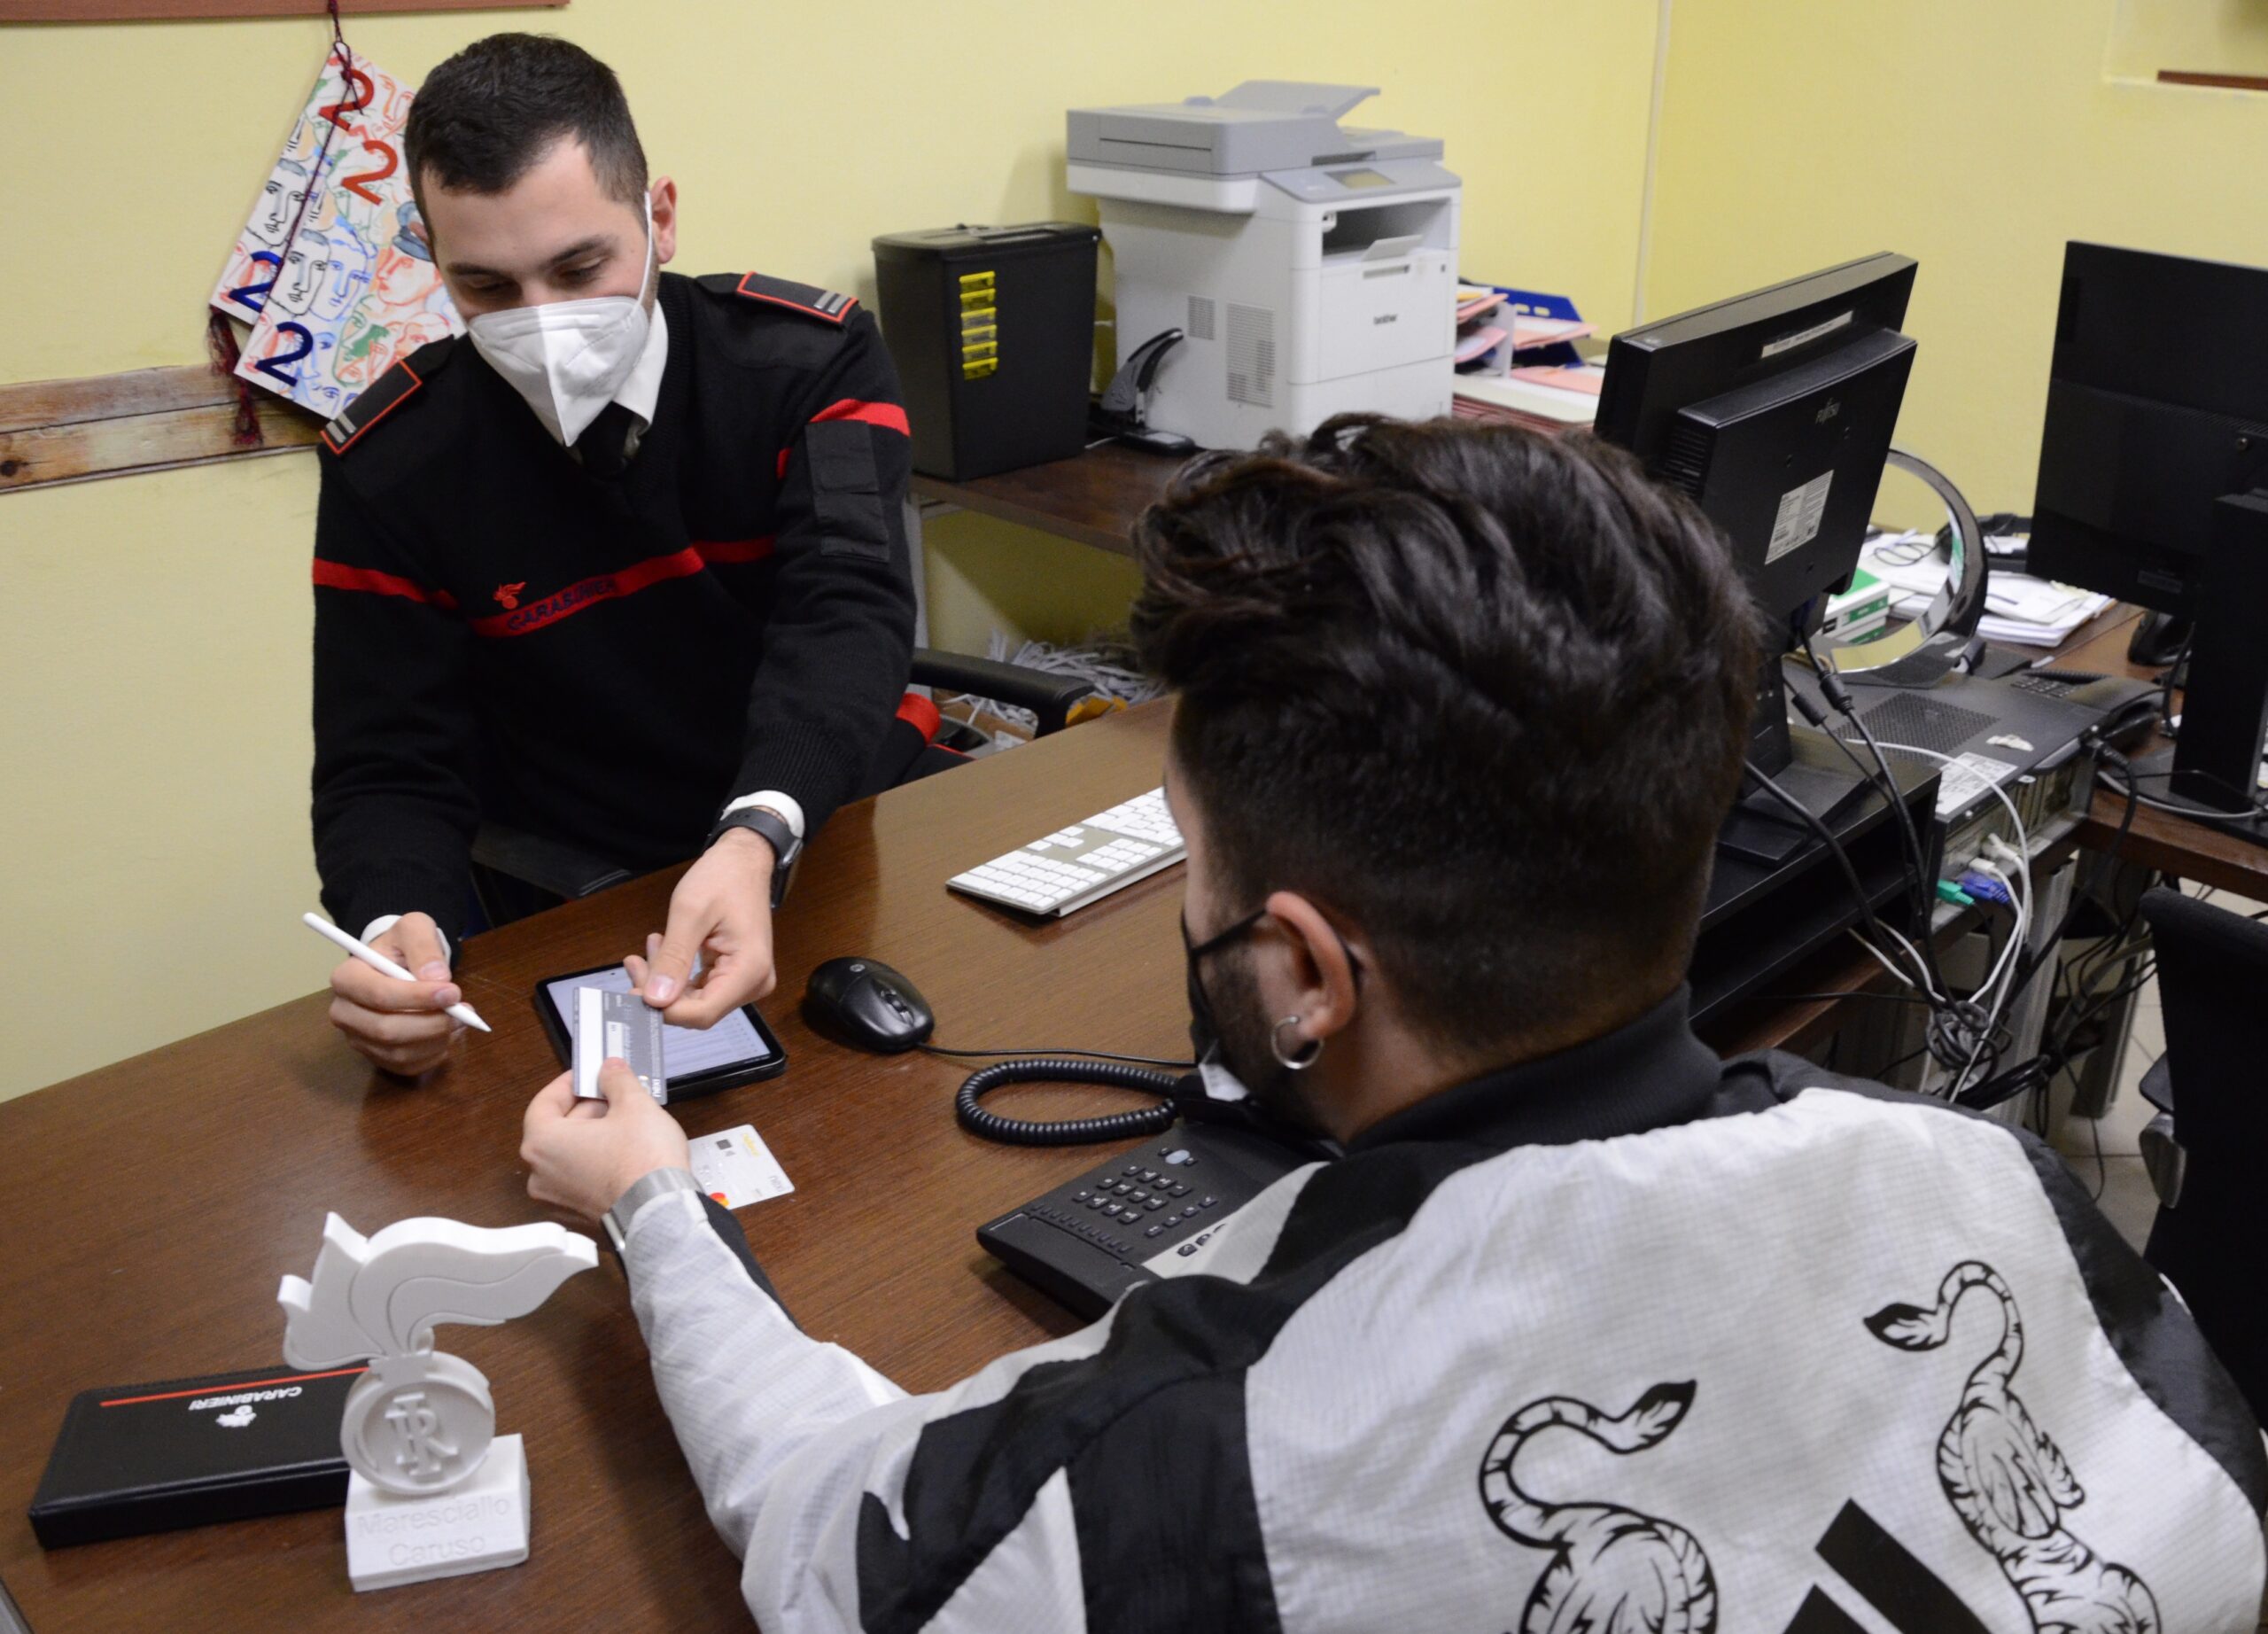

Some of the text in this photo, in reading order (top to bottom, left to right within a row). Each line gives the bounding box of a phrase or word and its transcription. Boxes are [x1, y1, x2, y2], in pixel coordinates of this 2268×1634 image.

[318, 68, 375, 132] 2
[340, 139, 399, 206] 2
[255, 321, 314, 387] 2
[189, 1386, 303, 1411] CARABINIERI
[358, 1495, 511, 1537] Maresciallo
[388, 1536, 486, 1567] Caruso
